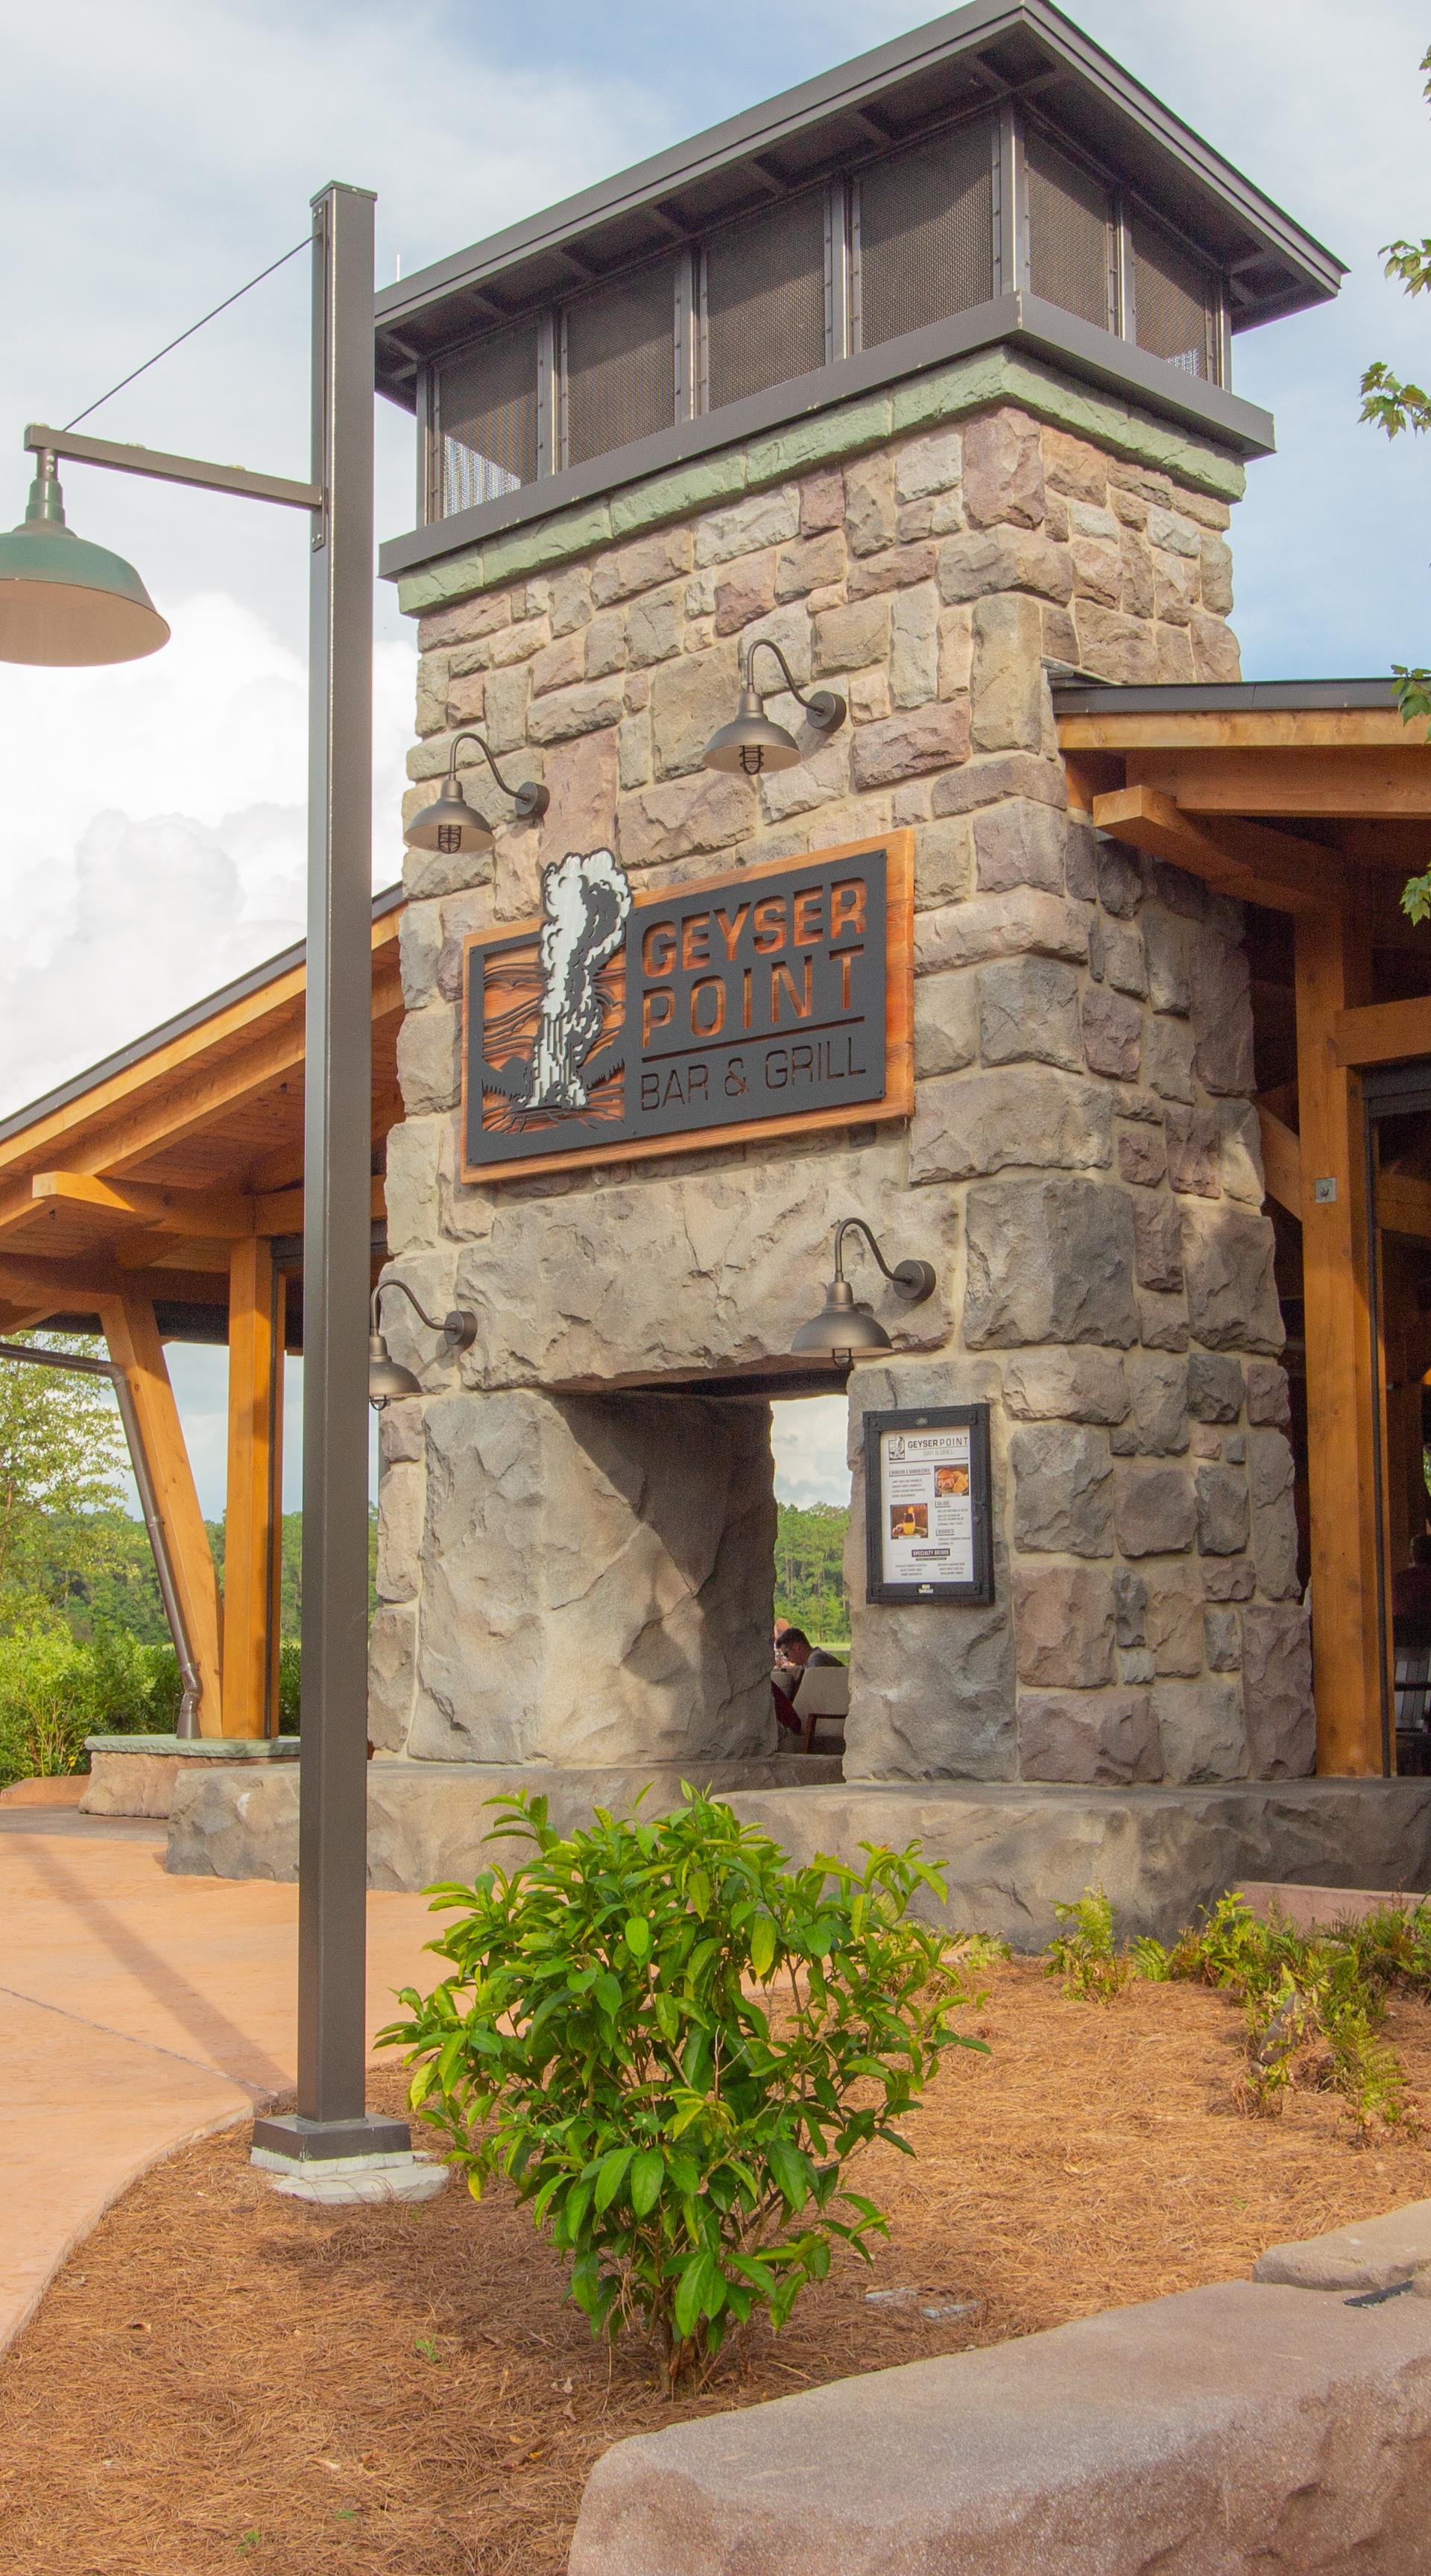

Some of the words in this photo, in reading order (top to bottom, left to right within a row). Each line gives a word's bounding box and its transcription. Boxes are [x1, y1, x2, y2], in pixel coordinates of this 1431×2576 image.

[642, 876, 868, 979] GEYSER
[642, 944, 865, 1049] POINT
[641, 1063, 710, 1112] BAR
[724, 1056, 751, 1096] &
[765, 1036, 867, 1091] GRILL
[908, 1439, 938, 1448] GEYSER
[940, 1437, 968, 1447] POINT
